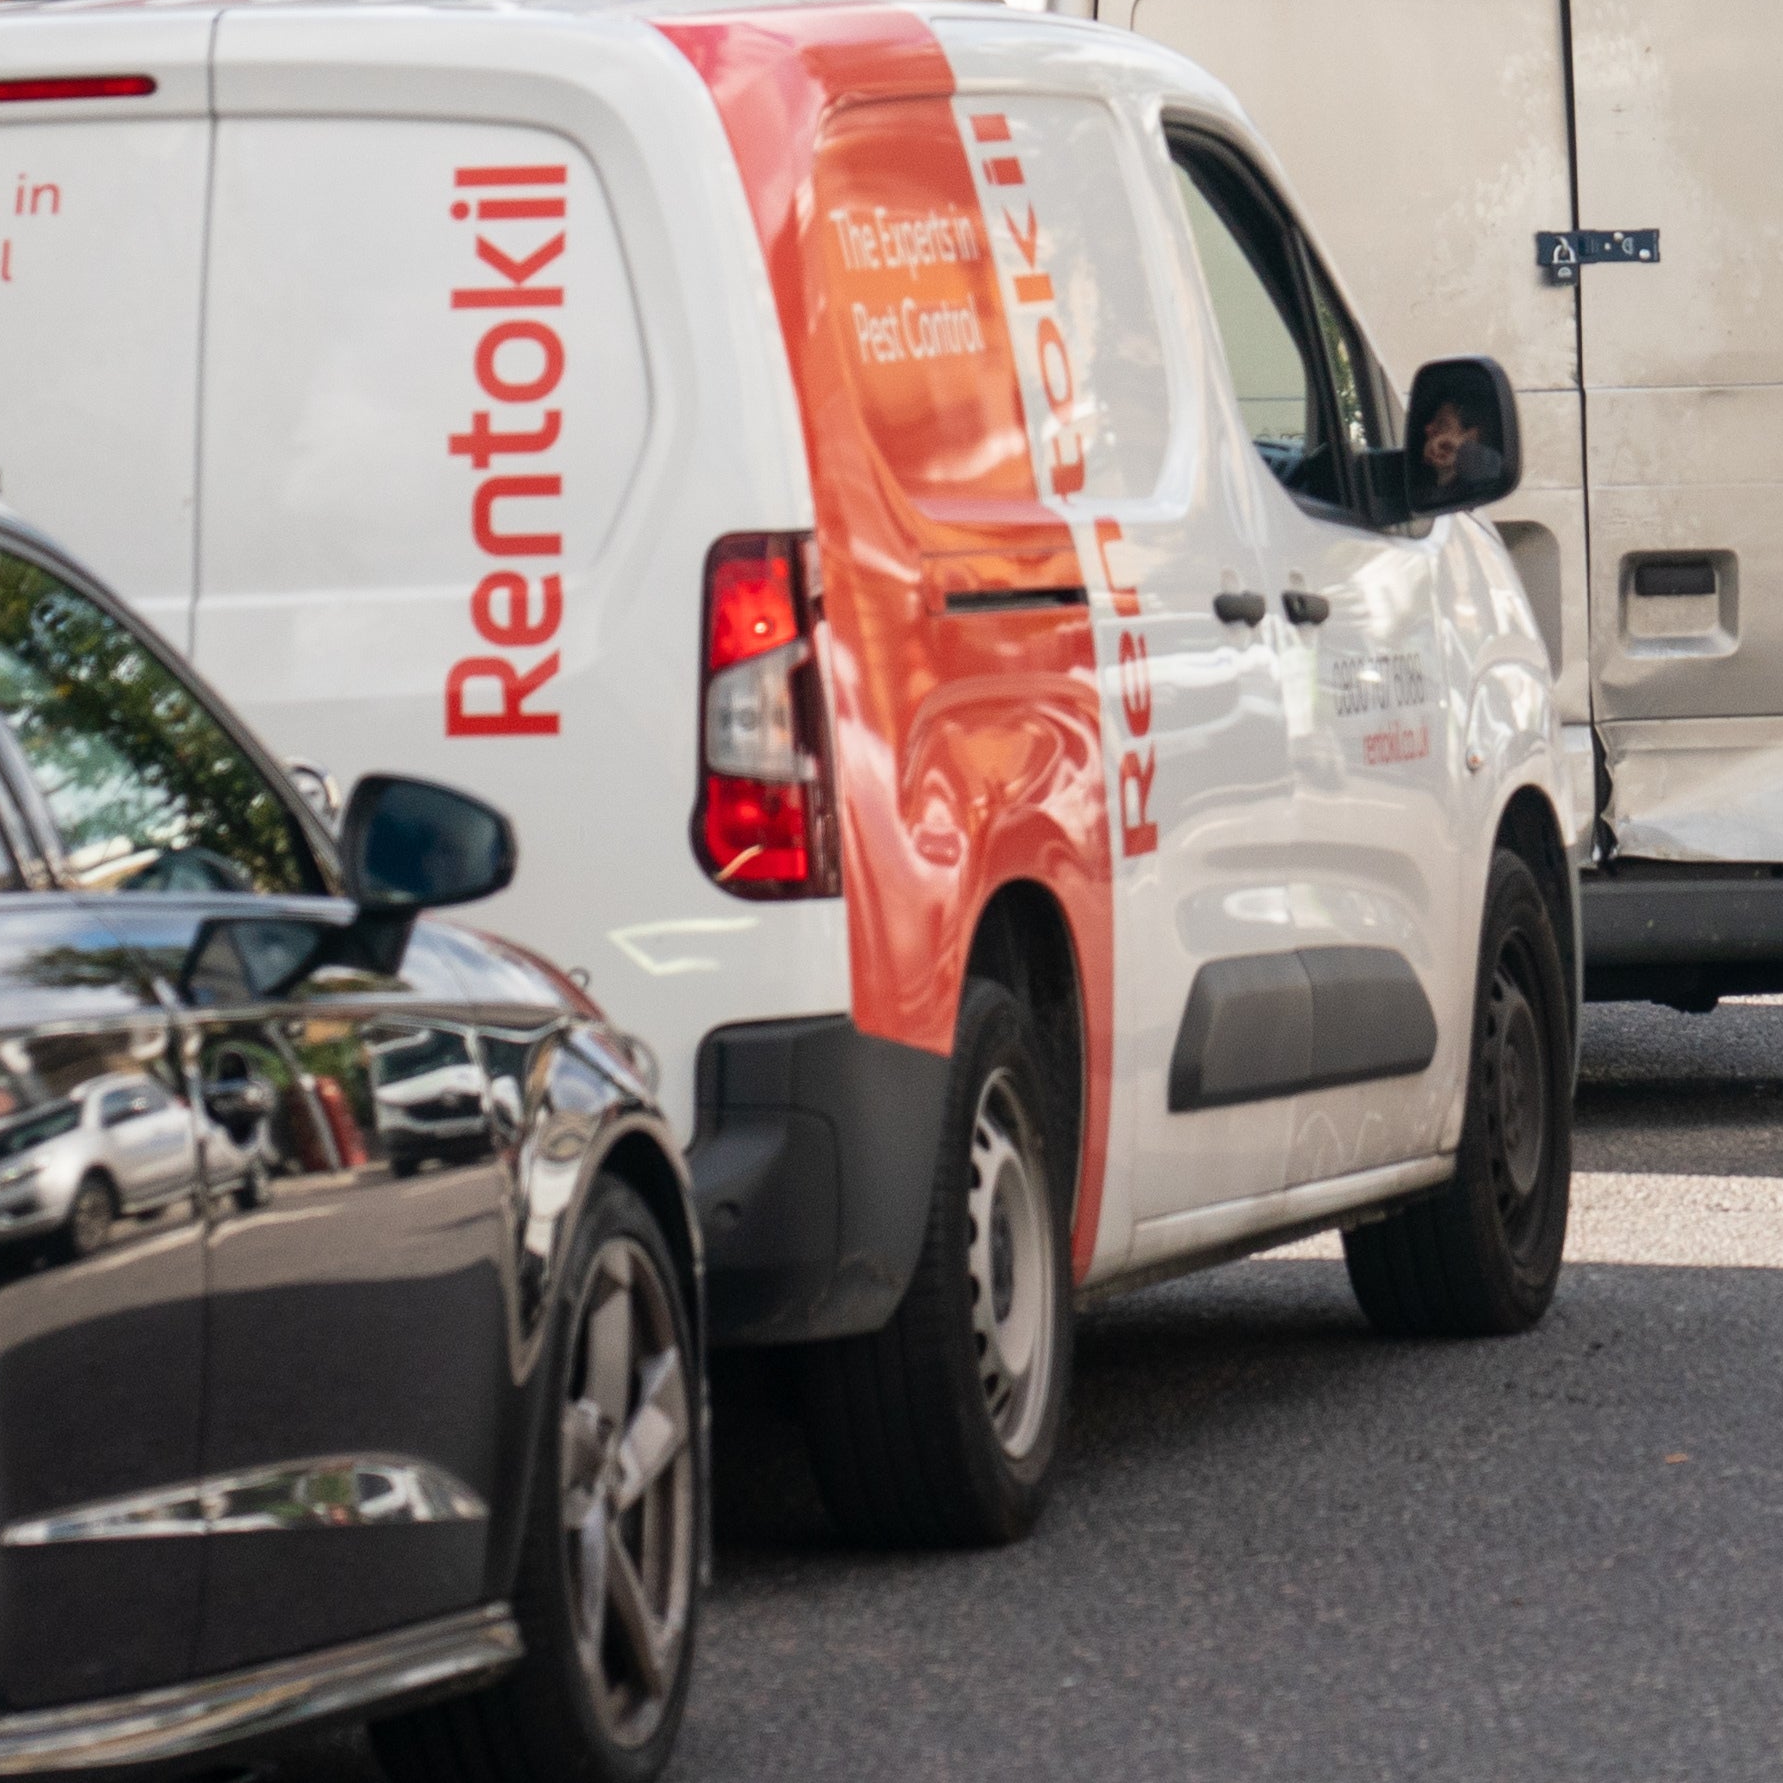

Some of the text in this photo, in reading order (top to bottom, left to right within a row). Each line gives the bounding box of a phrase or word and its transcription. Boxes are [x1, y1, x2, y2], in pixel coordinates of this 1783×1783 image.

[14, 173, 62, 216] in
[828, 206, 882, 272] The
[851, 292, 987, 364] Pest Control
[445, 165, 568, 737] Rentokil
